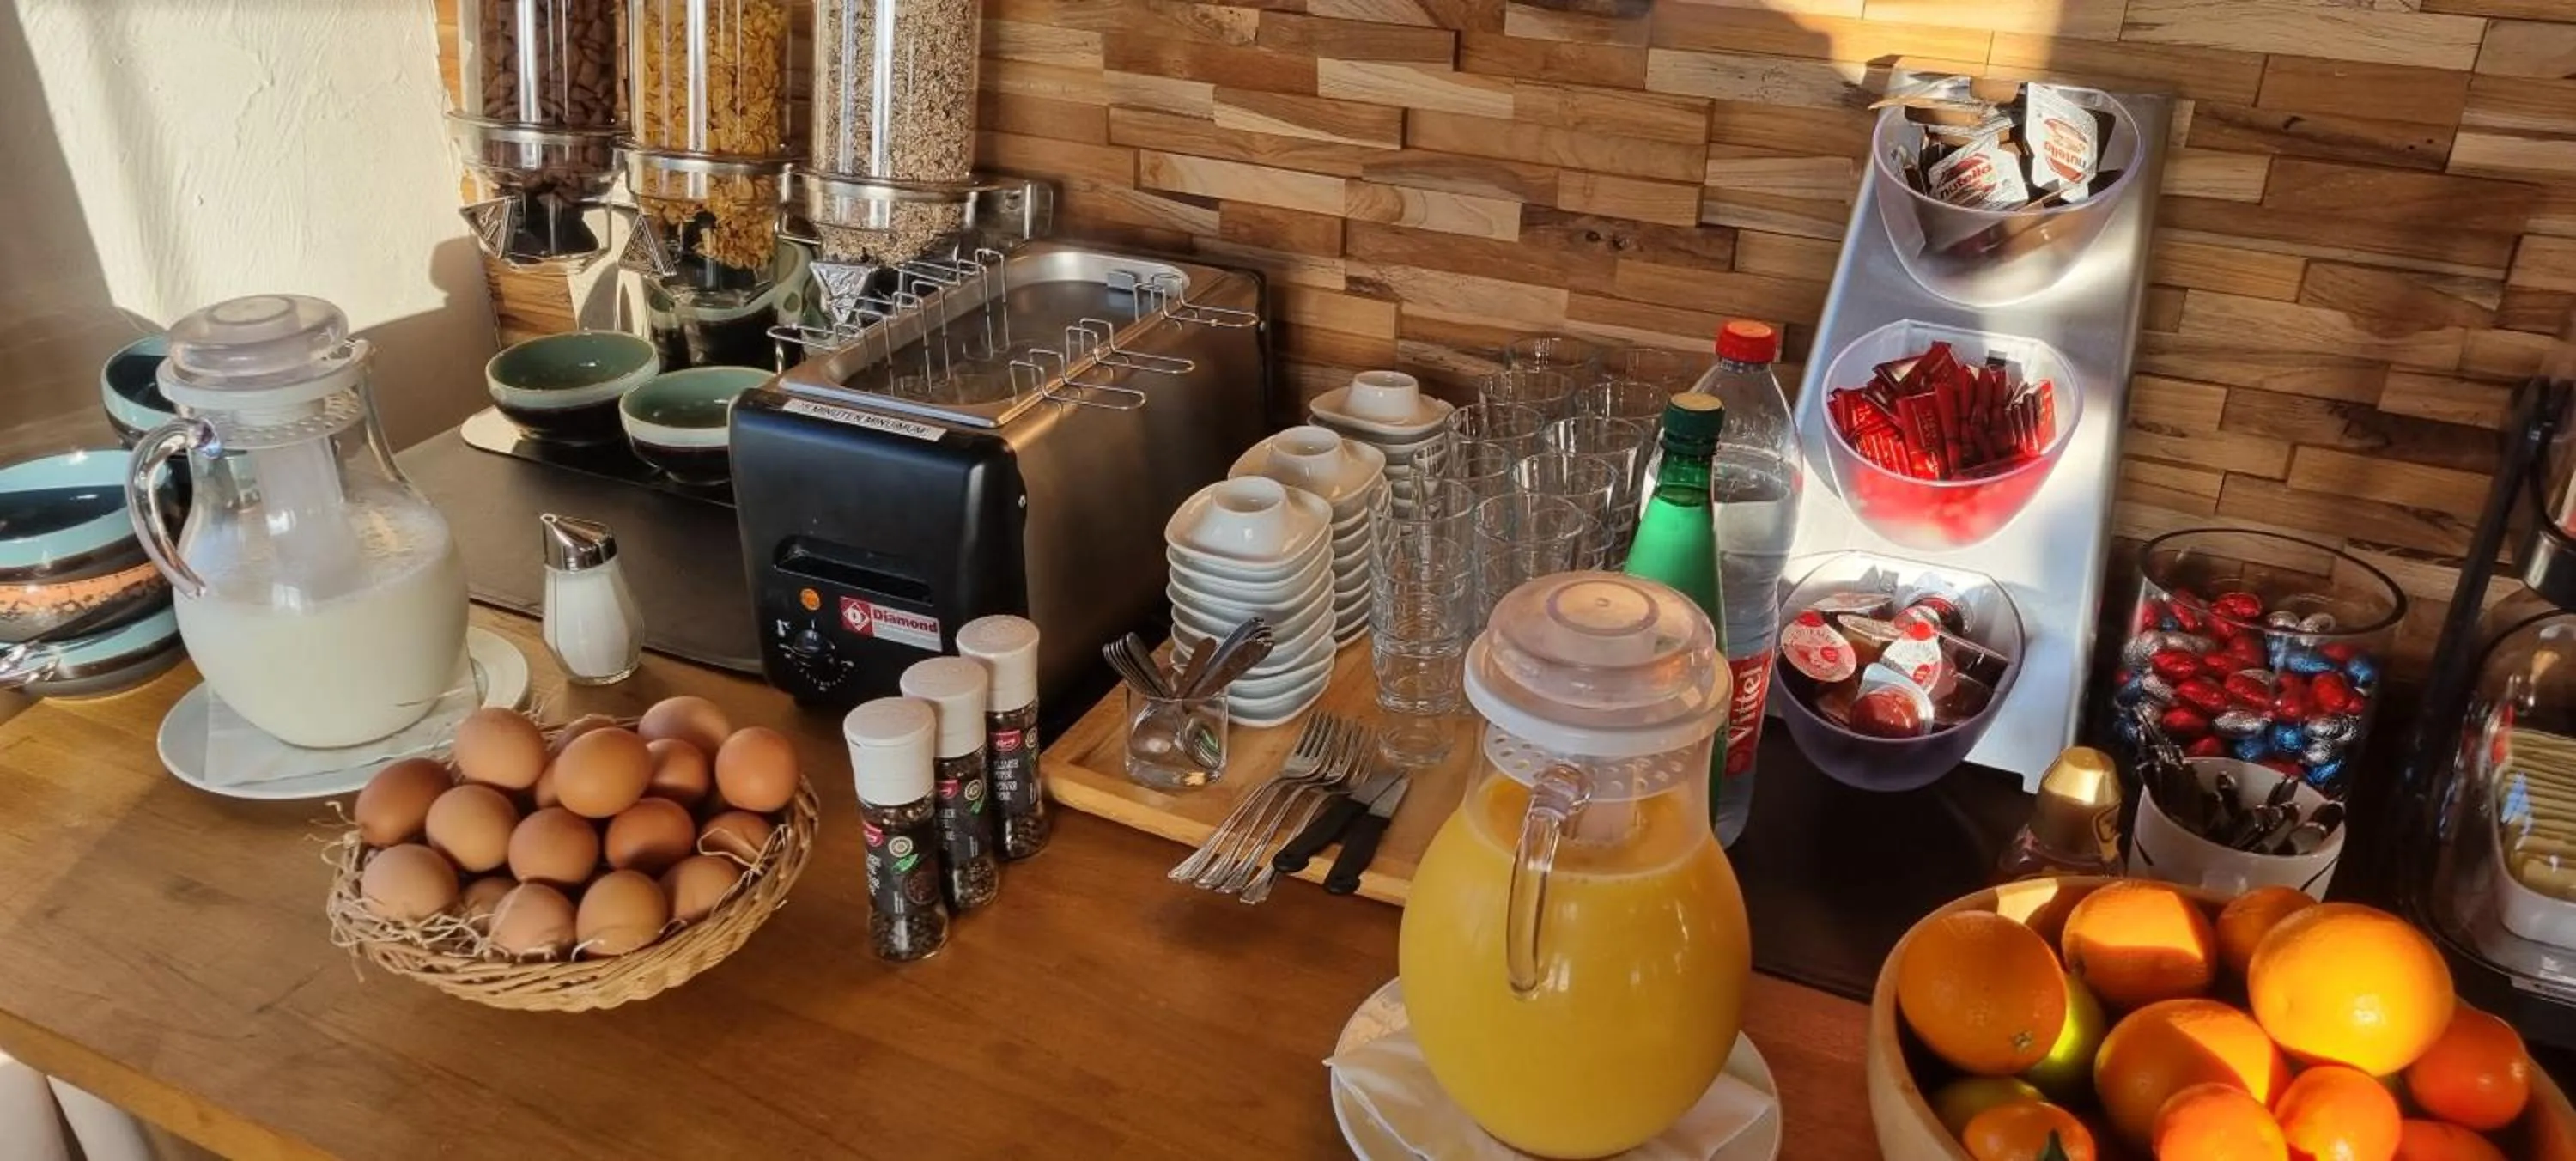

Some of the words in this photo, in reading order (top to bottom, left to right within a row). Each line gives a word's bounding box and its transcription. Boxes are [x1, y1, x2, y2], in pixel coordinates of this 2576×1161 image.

[2044, 140, 2087, 168] nutella
[1940, 164, 1992, 198] nutella
[872, 609, 938, 633] Diamond
[1727, 666, 1763, 747] Vittel
